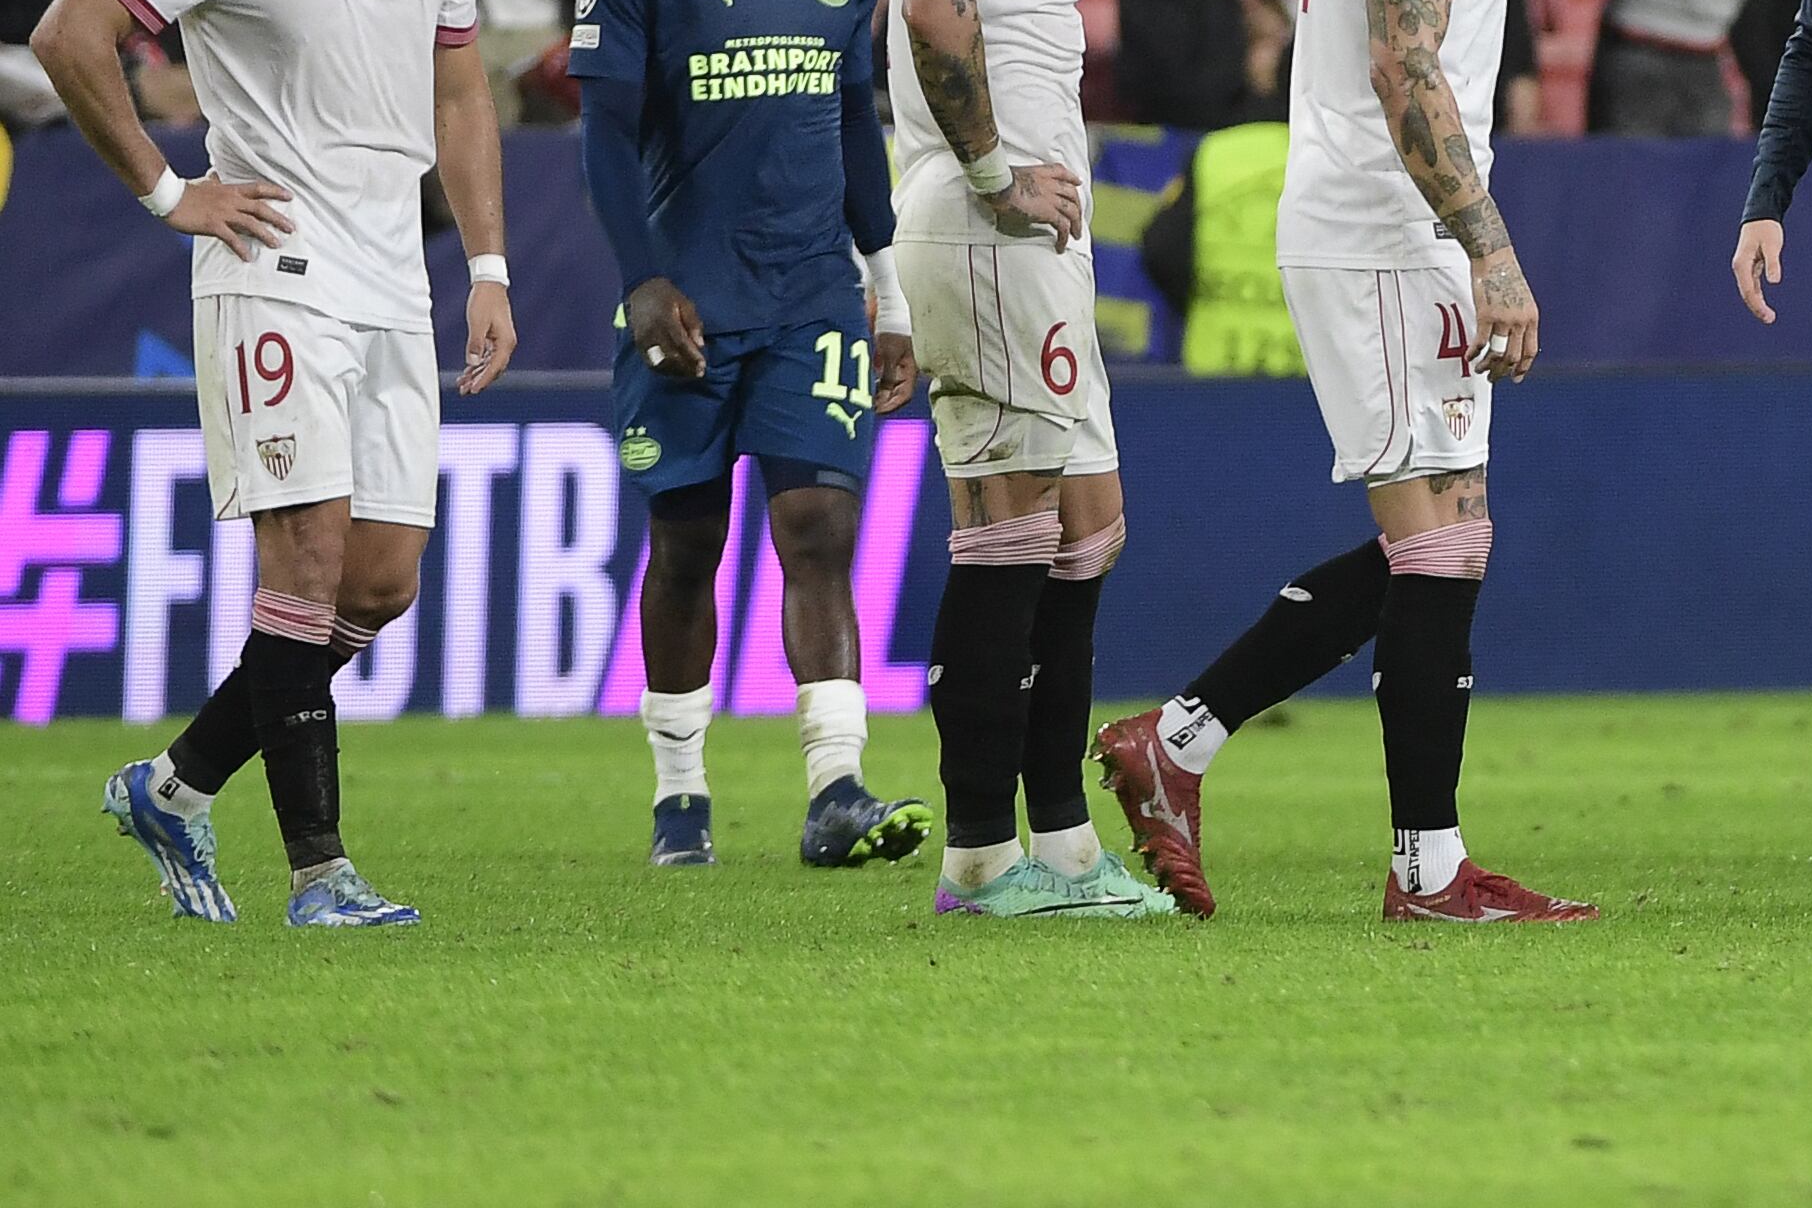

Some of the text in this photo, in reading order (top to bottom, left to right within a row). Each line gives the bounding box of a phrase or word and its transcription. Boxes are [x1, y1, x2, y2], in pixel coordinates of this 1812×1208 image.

[688, 48, 843, 78] BRAINPORT
[691, 72, 836, 102] EINDHOVEN
[234, 331, 295, 414] 19
[811, 330, 873, 409] 11
[1040, 321, 1078, 396] 6
[1434, 302, 1472, 378] 4
[0, 416, 931, 726] #FTBAL
